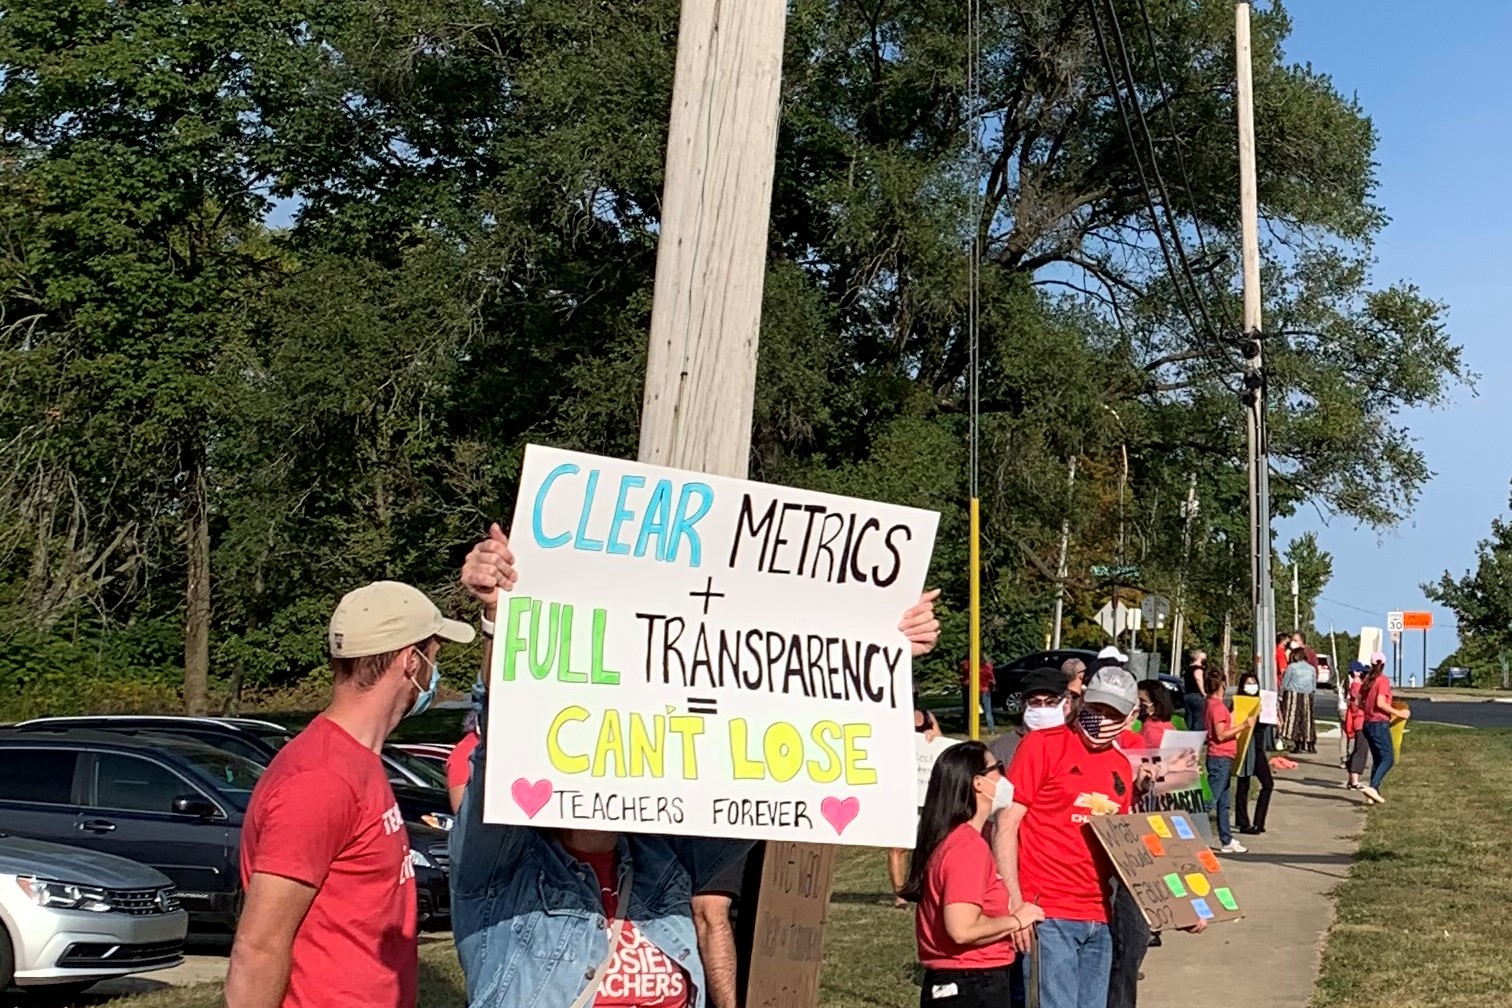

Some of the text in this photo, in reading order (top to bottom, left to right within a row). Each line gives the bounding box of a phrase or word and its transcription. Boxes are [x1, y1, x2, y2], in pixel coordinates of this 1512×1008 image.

[532, 463, 912, 588] CLEAR METRICS
[503, 596, 903, 709] FULL TRANSPARENCY
[1389, 621, 1402, 630] 30
[546, 704, 705, 781] CAN'T
[728, 717, 878, 785] LOSE
[554, 788, 813, 829] TEACHERS FOREVER
[597, 973, 683, 998] ACHERS
